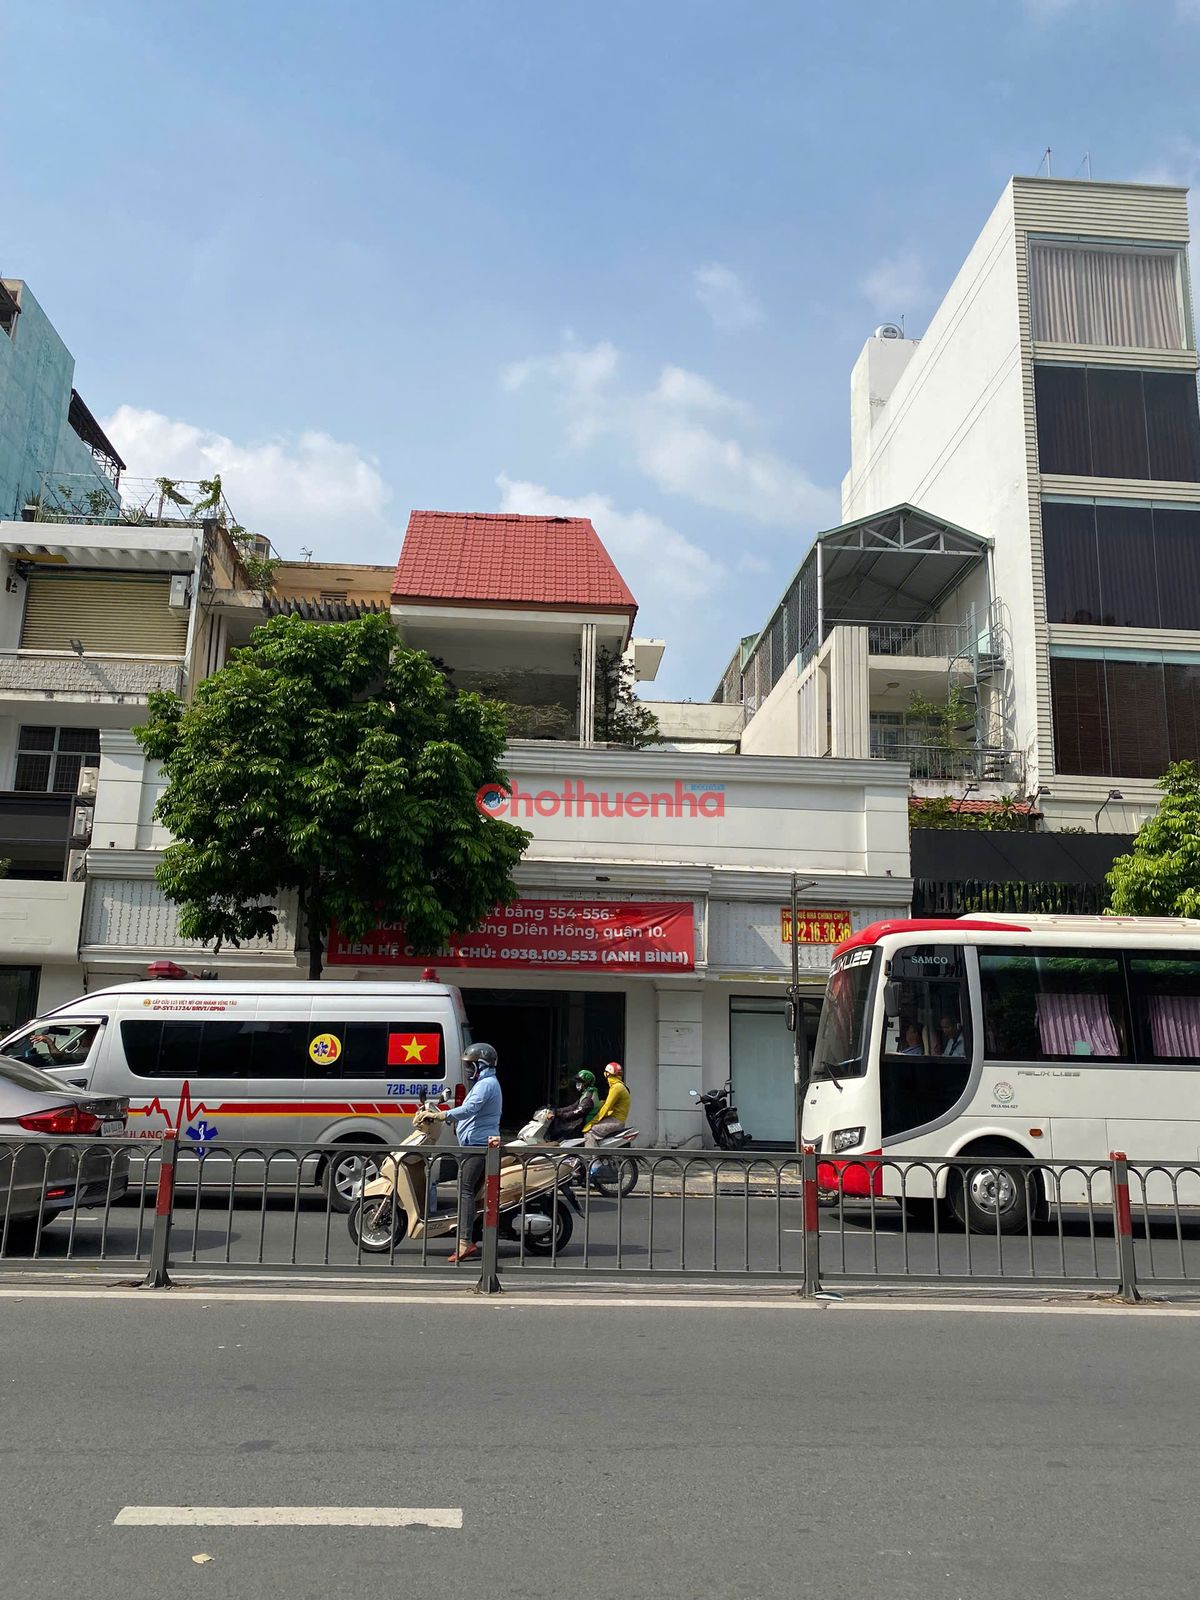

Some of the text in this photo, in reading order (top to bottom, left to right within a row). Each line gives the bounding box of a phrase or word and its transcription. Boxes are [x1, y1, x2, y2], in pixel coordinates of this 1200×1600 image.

[512, 923, 548, 936] Diên
[553, 923, 599, 939] Hồng,
[603, 926, 642, 940] quận
[647, 926, 667, 938] 10.
[378, 942, 399, 959] HỆ
[459, 943, 497, 958] CHỦ:
[500, 948, 597, 962] 0938.109.553
[601, 950, 641, 964] (ANH
[645, 948, 689, 965] BÌNH)
[911, 955, 948, 965] SAMCO
